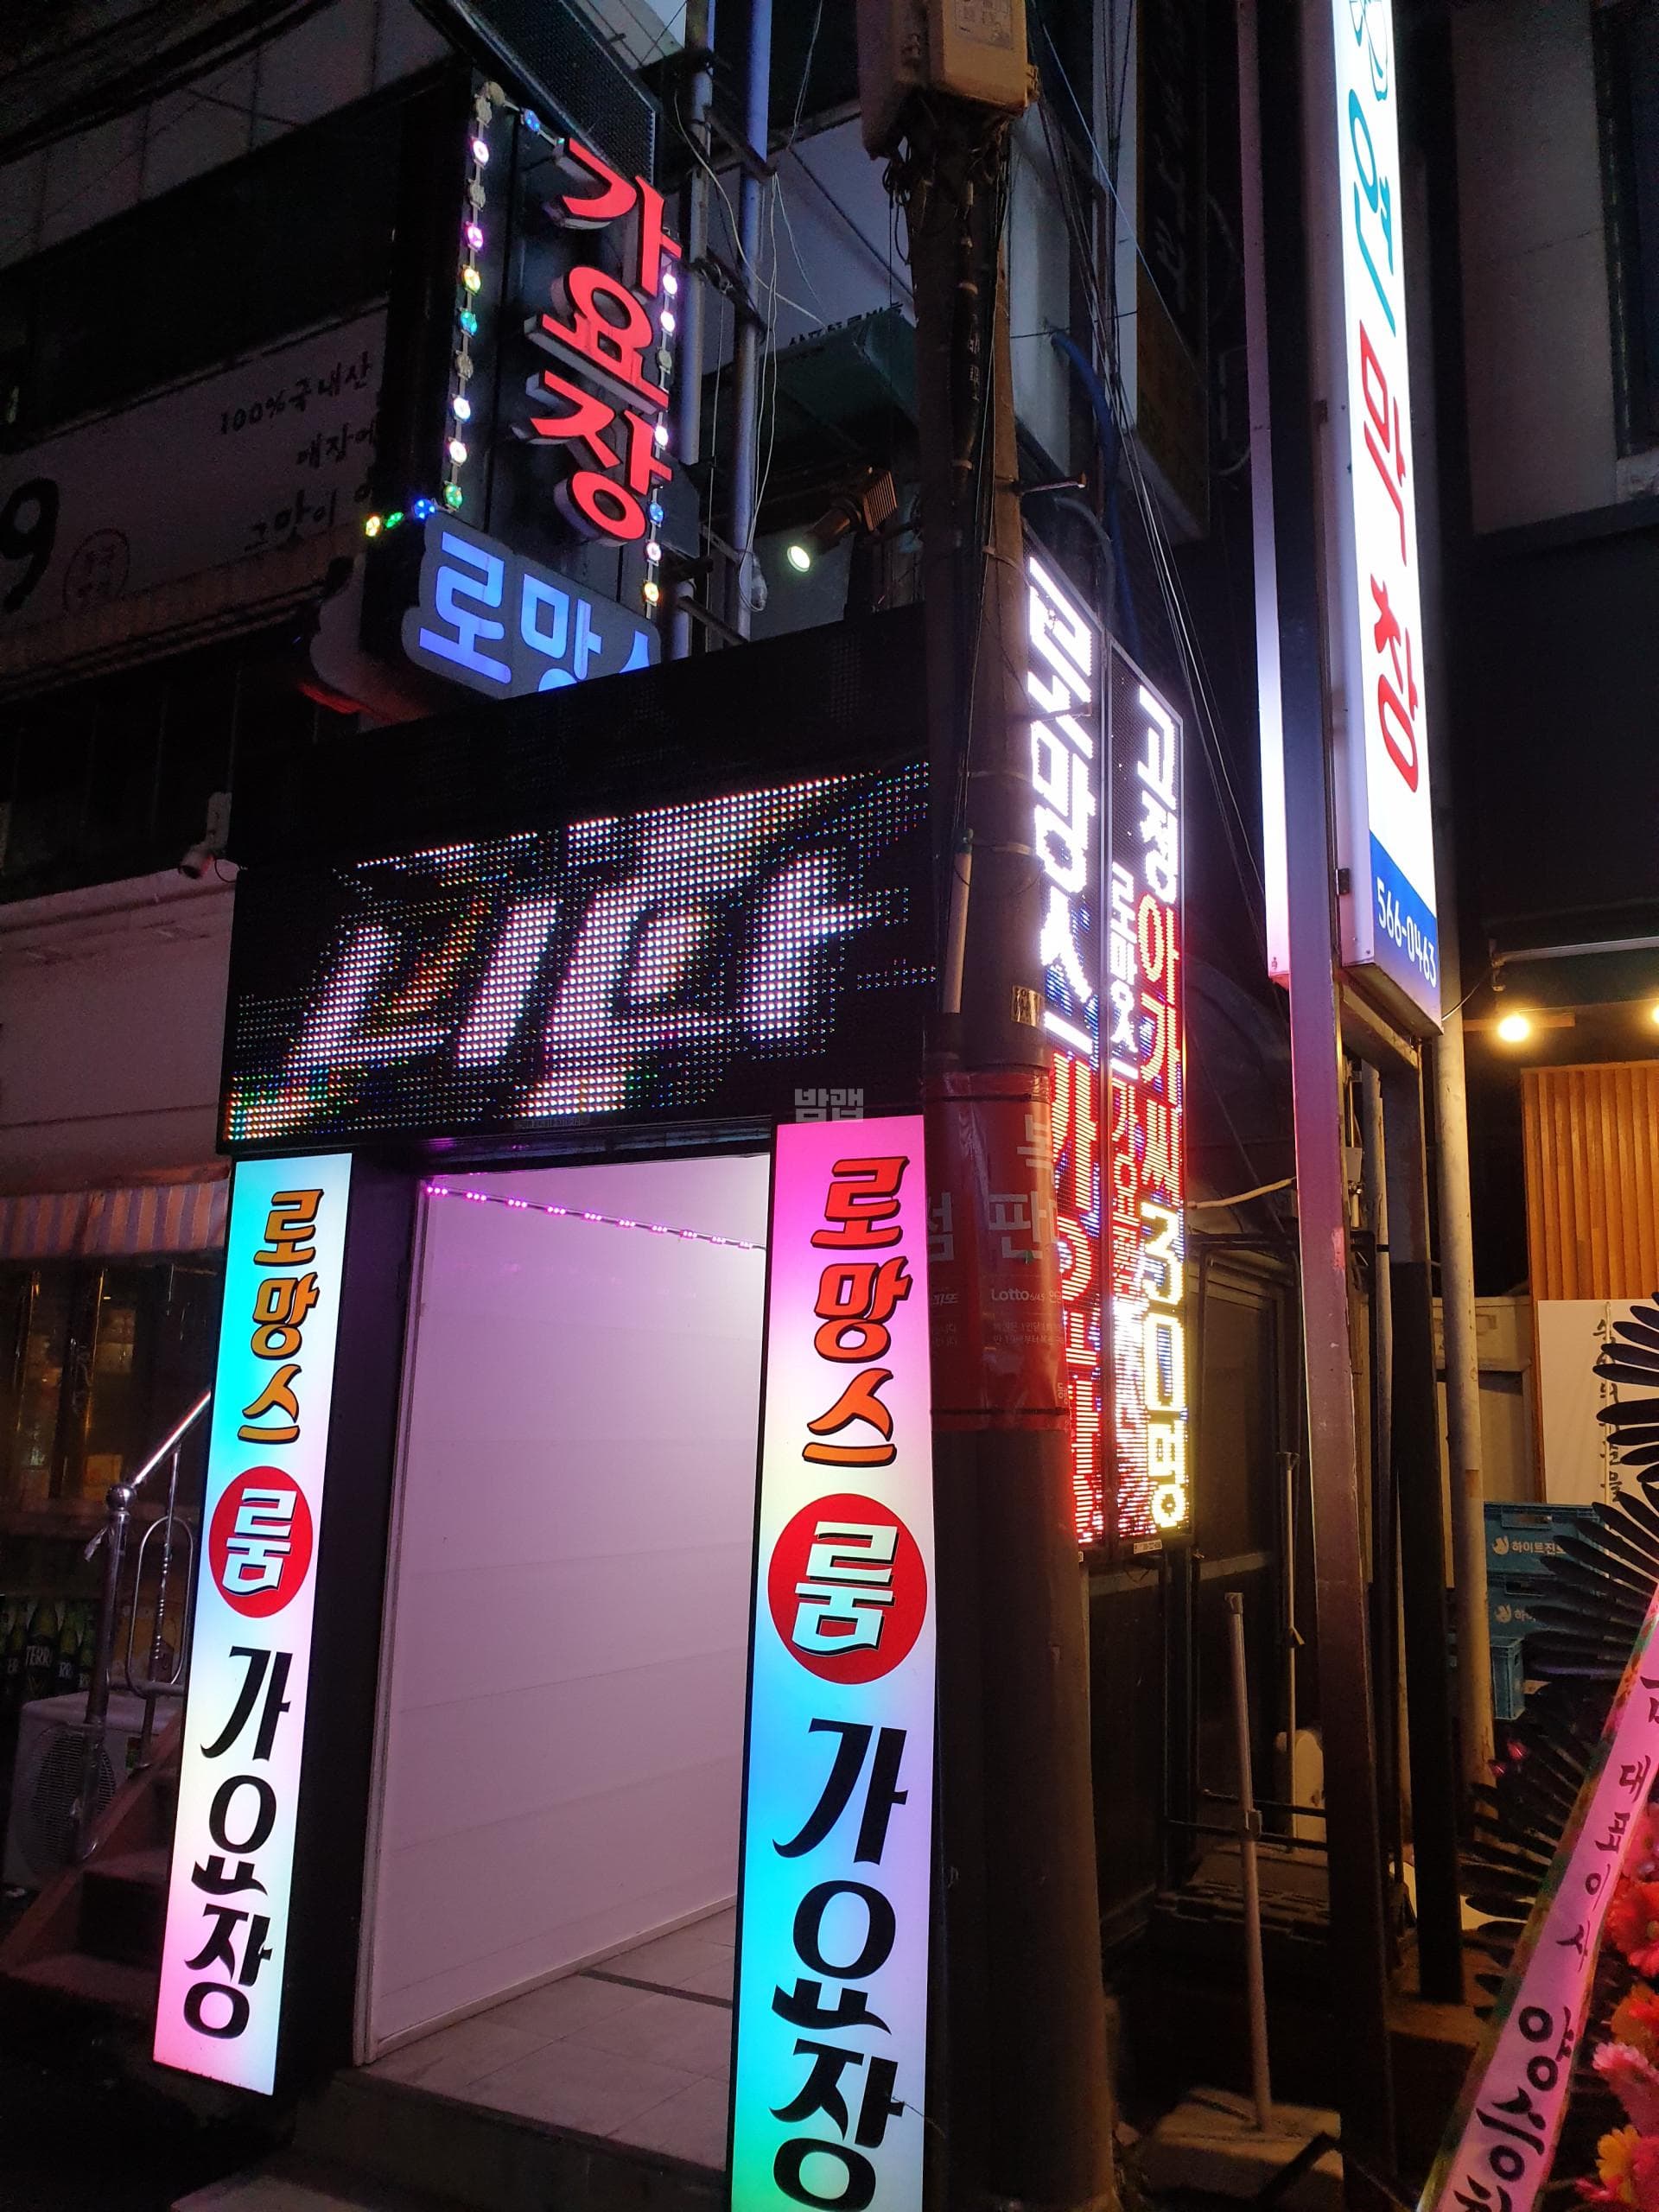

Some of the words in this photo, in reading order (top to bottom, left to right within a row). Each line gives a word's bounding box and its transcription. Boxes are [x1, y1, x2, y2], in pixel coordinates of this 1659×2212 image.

[530, 137, 682, 540] 가요장
[419, 531, 650, 691] 로망
[1377, 879, 1437, 988] 566-0463
[236, 1188, 323, 1445] 로망스
[802, 1155, 911, 1469] 로망스
[991, 1287, 1030, 1301] Lotto
[219, 1487, 297, 1598] 룸
[792, 1520, 900, 1660] 룸
[183, 1645, 293, 2039] 가요장
[770, 1716, 908, 2210] 가요장
